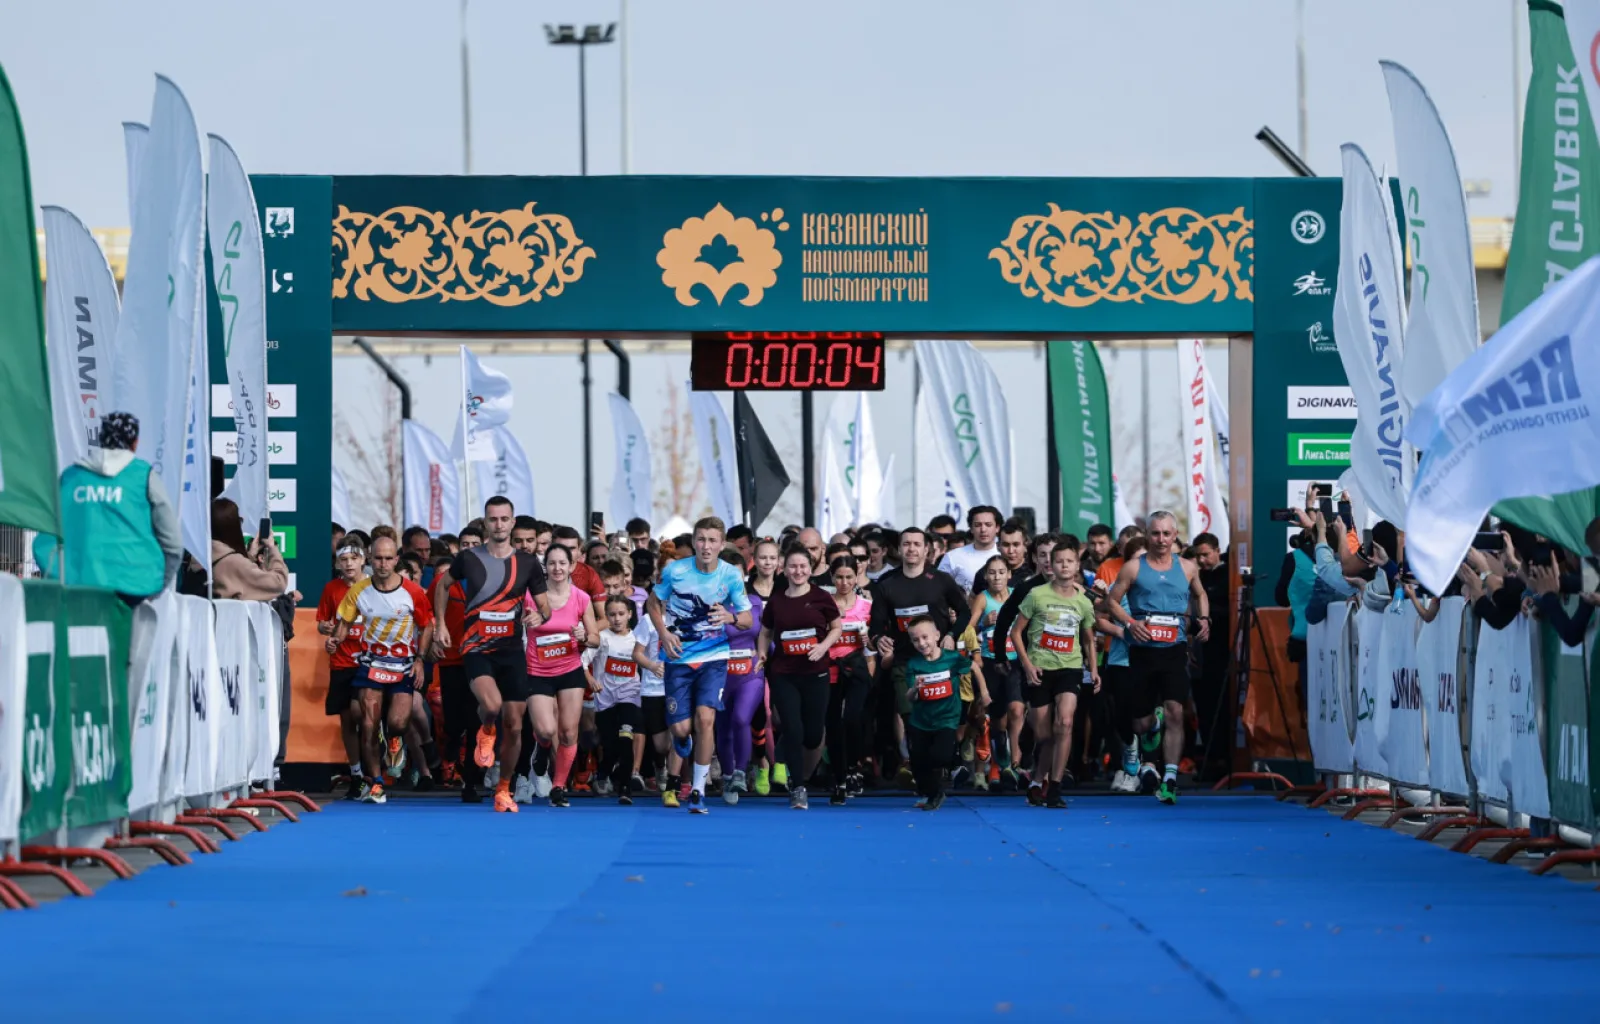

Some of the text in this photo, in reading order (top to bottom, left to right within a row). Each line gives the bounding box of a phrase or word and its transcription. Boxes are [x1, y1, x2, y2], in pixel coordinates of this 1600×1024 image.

[802, 207, 929, 246] КАЗАНСКИЙ
[802, 246, 929, 276] НАЦИОНАЛЬНЫЙ
[802, 277, 929, 302] ПОЛУМАРАФОН
[266, 340, 279, 349] 013
[725, 342, 881, 388] 0:00:04
[73, 485, 122, 503] СМИ
[349, 628, 361, 636] 53
[485, 625, 508, 634] 5555
[1151, 629, 1172, 639] 5313
[837, 635, 856, 644] 135
[543, 646, 567, 658] 5002
[789, 642, 811, 653] 5196
[611, 662, 632, 674] 5696
[923, 685, 947, 697] 5722
